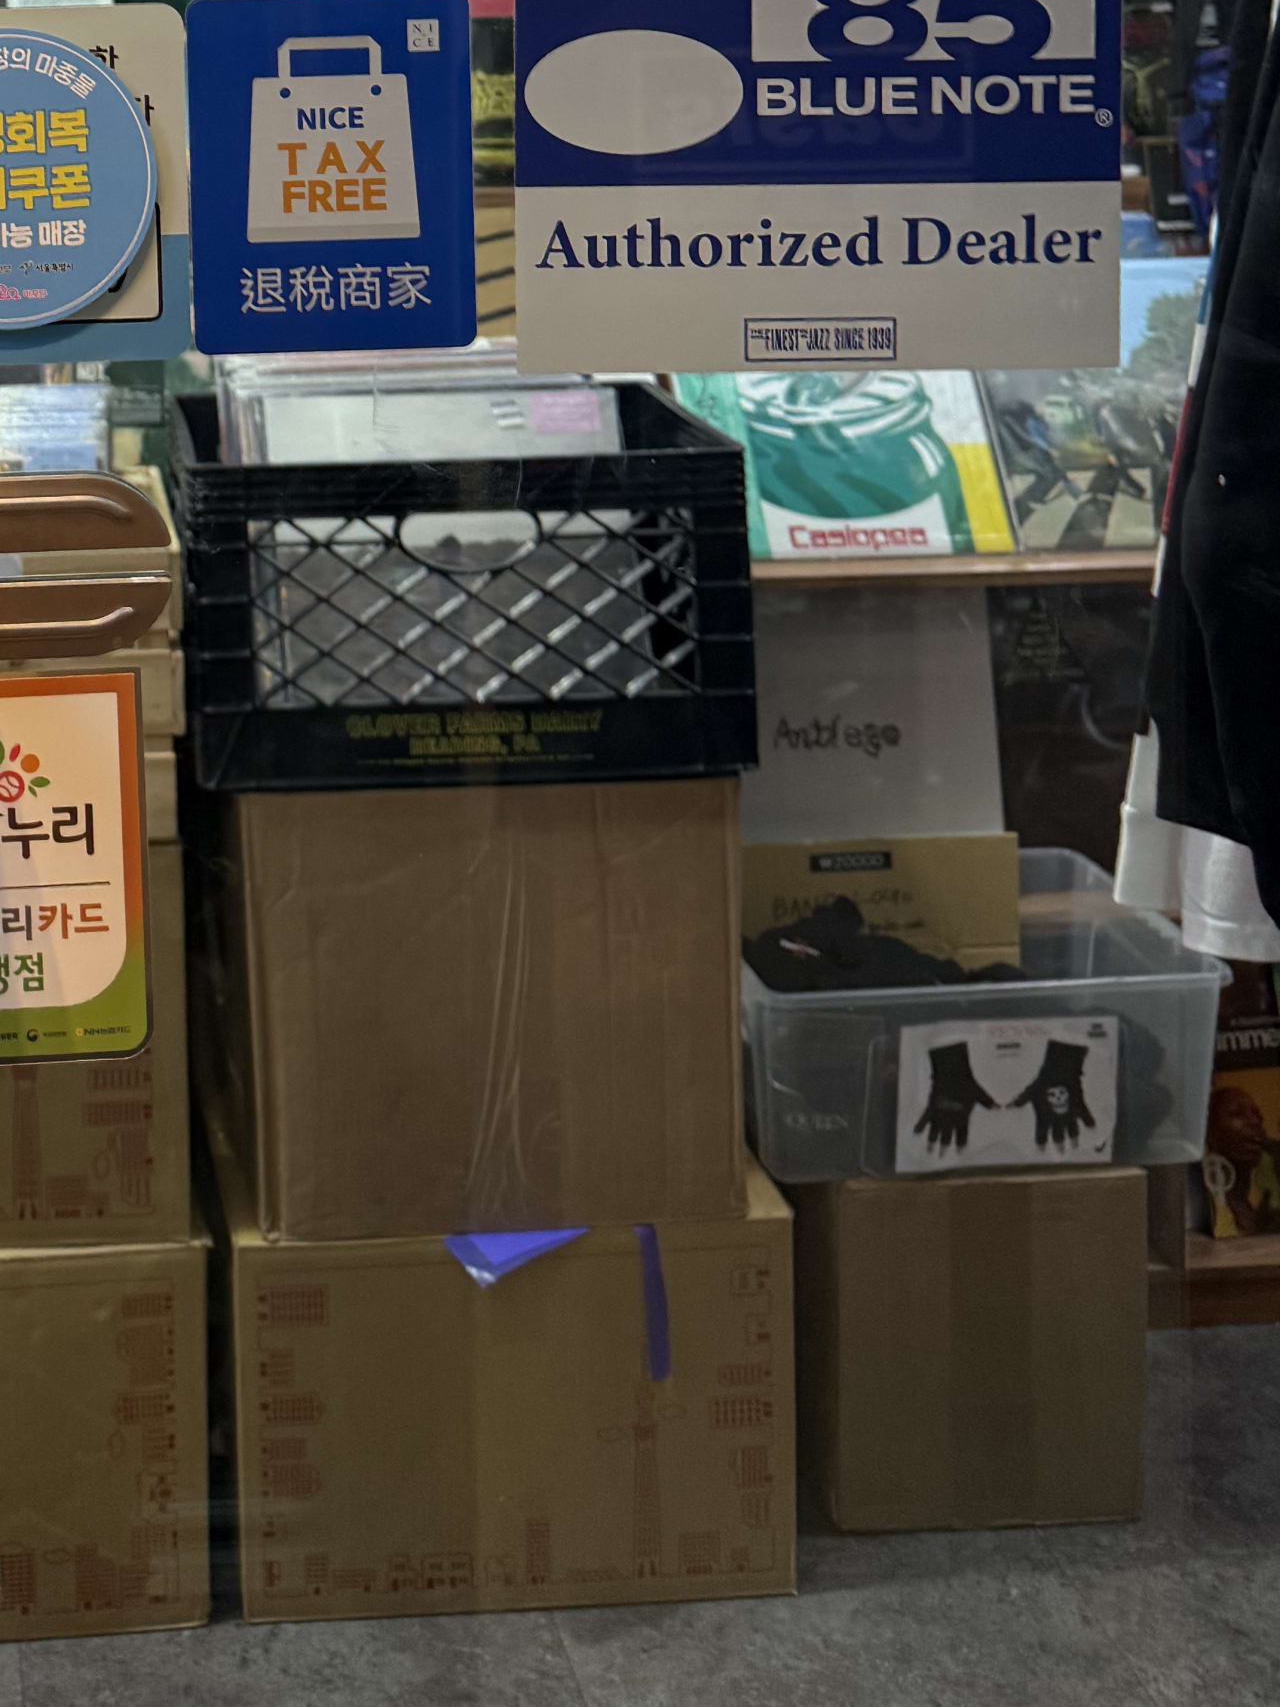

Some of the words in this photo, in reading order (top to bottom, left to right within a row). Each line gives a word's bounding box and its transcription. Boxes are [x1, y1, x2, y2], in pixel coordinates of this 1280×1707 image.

[35, 55, 97, 99] 마중물
[757, 77, 918, 116] BLUE
[932, 75, 1095, 114] NOTE
[297, 106, 364, 130] NICE
[278, 140, 386, 175] TAX
[282, 178, 387, 213] FREE
[38, 219, 86, 246] 매장
[535, 217, 882, 269] Authorized
[903, 215, 1102, 265] Dealer
[240, 262, 432, 314] 退稅商家
[764, 328, 799, 351] FINEST
[806, 328, 831, 351] JAZZ
[834, 328, 864, 351] SINCE
[868, 326, 891, 350] 1939
